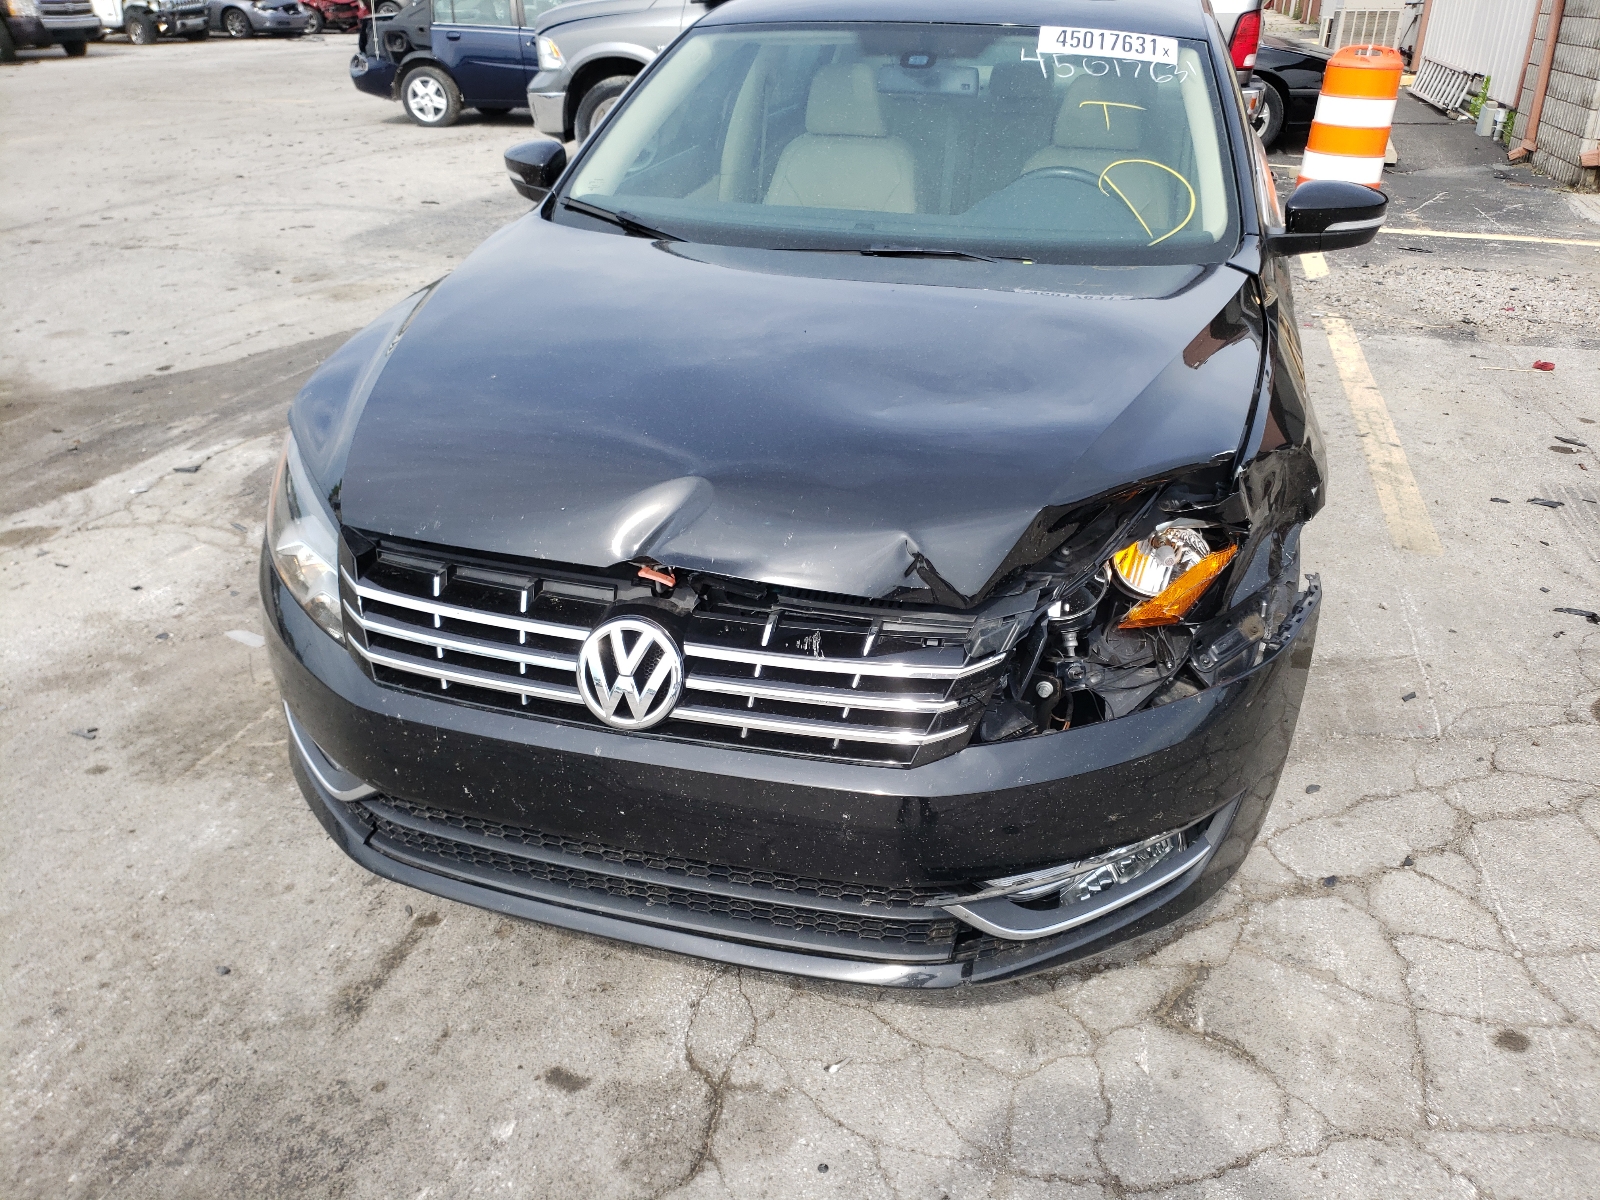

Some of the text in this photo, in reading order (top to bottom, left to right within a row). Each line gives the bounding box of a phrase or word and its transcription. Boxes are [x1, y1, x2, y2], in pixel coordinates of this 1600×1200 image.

[1056, 29, 1157, 56] 45017631
[1079, 101, 1148, 132] T
[580, 621, 680, 724] VW
